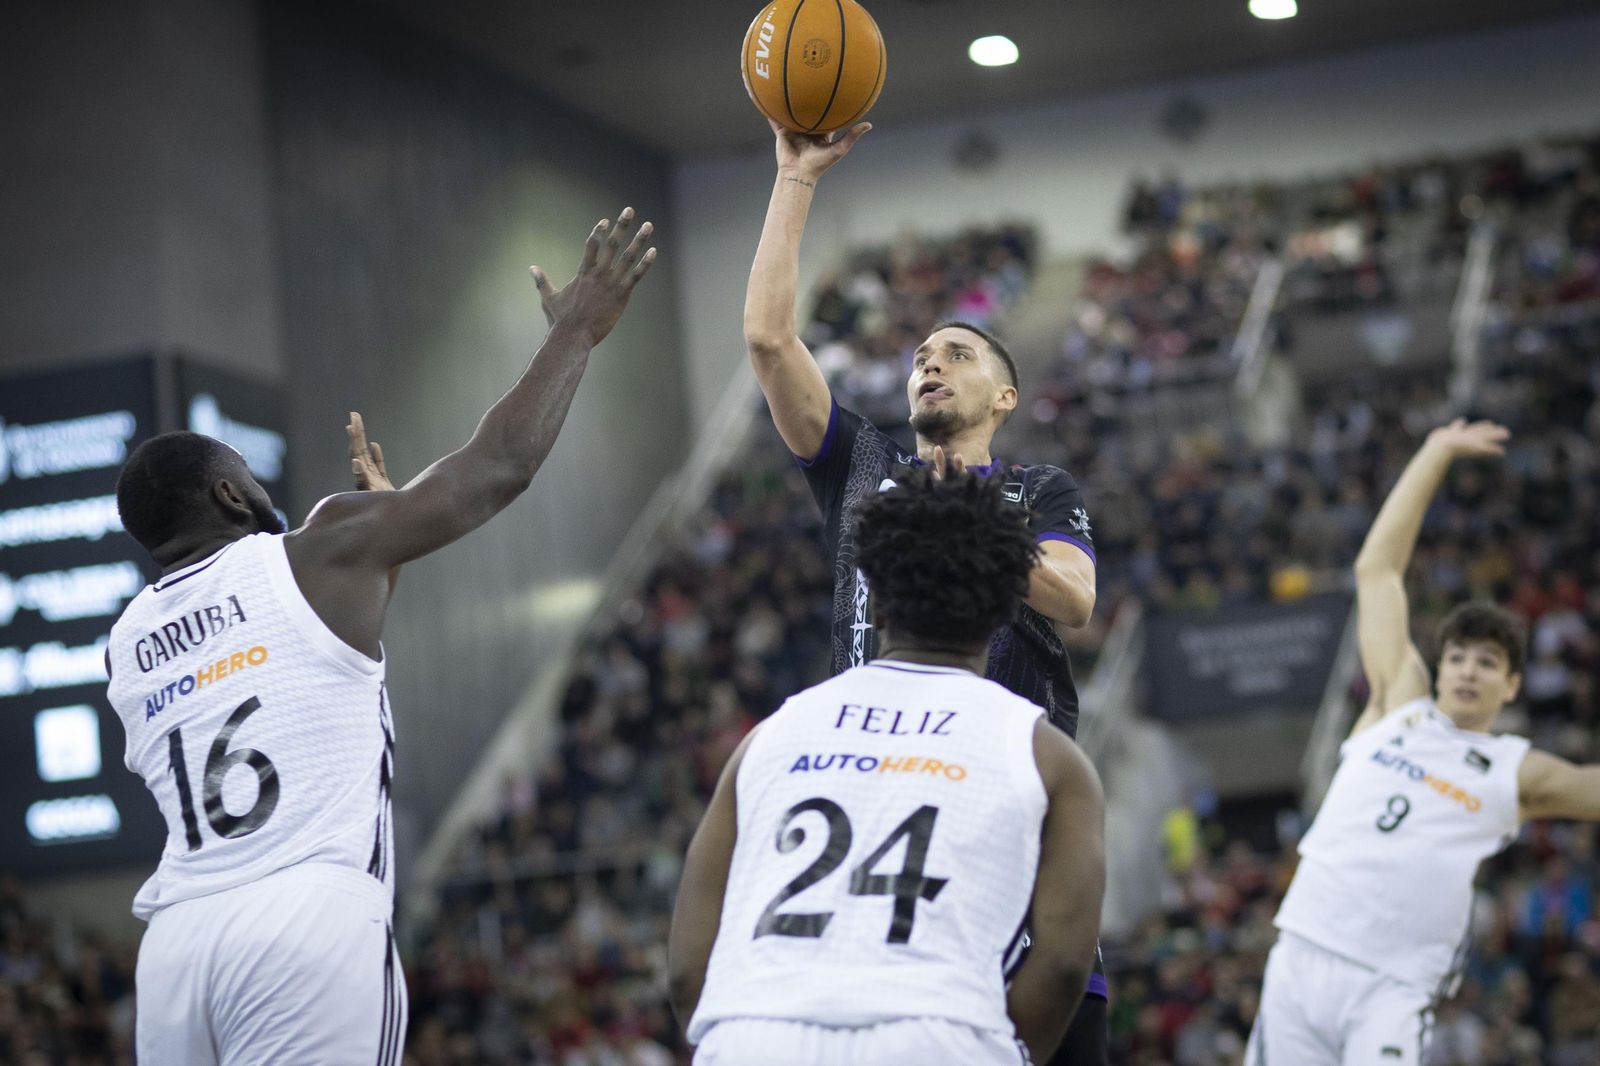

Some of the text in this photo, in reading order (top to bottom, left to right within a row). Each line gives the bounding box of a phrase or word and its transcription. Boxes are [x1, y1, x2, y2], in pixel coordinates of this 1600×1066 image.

[136, 594, 247, 673] GARUBA
[145, 645, 268, 722] AUTOHERO
[834, 704, 957, 735] FELIZ
[168, 695, 280, 851] 16
[789, 754, 966, 781] AUTOHERO
[1376, 794, 1410, 832] 9
[753, 797, 950, 944] 24
